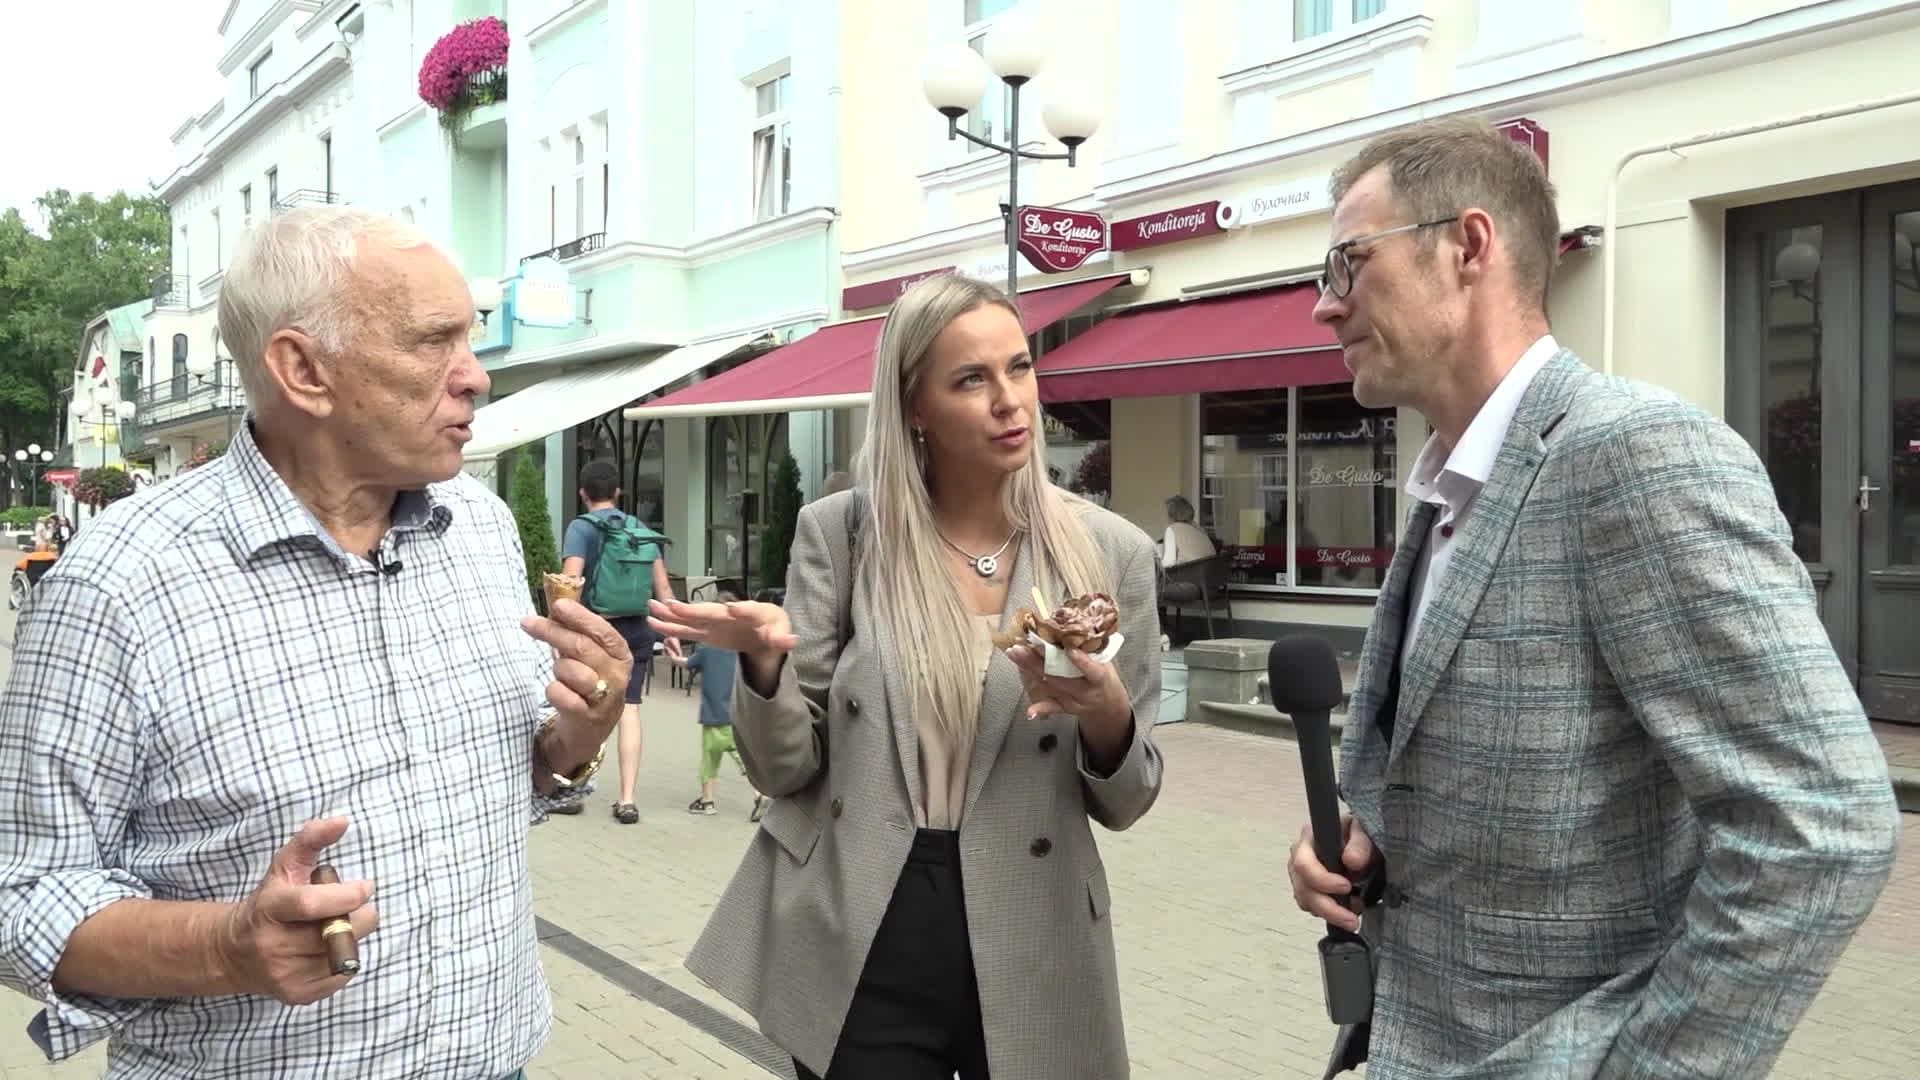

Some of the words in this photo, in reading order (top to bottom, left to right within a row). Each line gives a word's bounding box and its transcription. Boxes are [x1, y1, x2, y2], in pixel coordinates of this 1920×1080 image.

[1251, 191, 1310, 216] Булочная
[1024, 214, 1051, 234] De
[1053, 218, 1101, 242] Gusto
[1137, 208, 1206, 239] Konditoreja
[1041, 240, 1086, 257] Konditoreja
[1310, 465, 1333, 484] De
[1336, 464, 1384, 487] Gusto
[1317, 549, 1334, 562] De
[1336, 549, 1371, 566] Gusto
